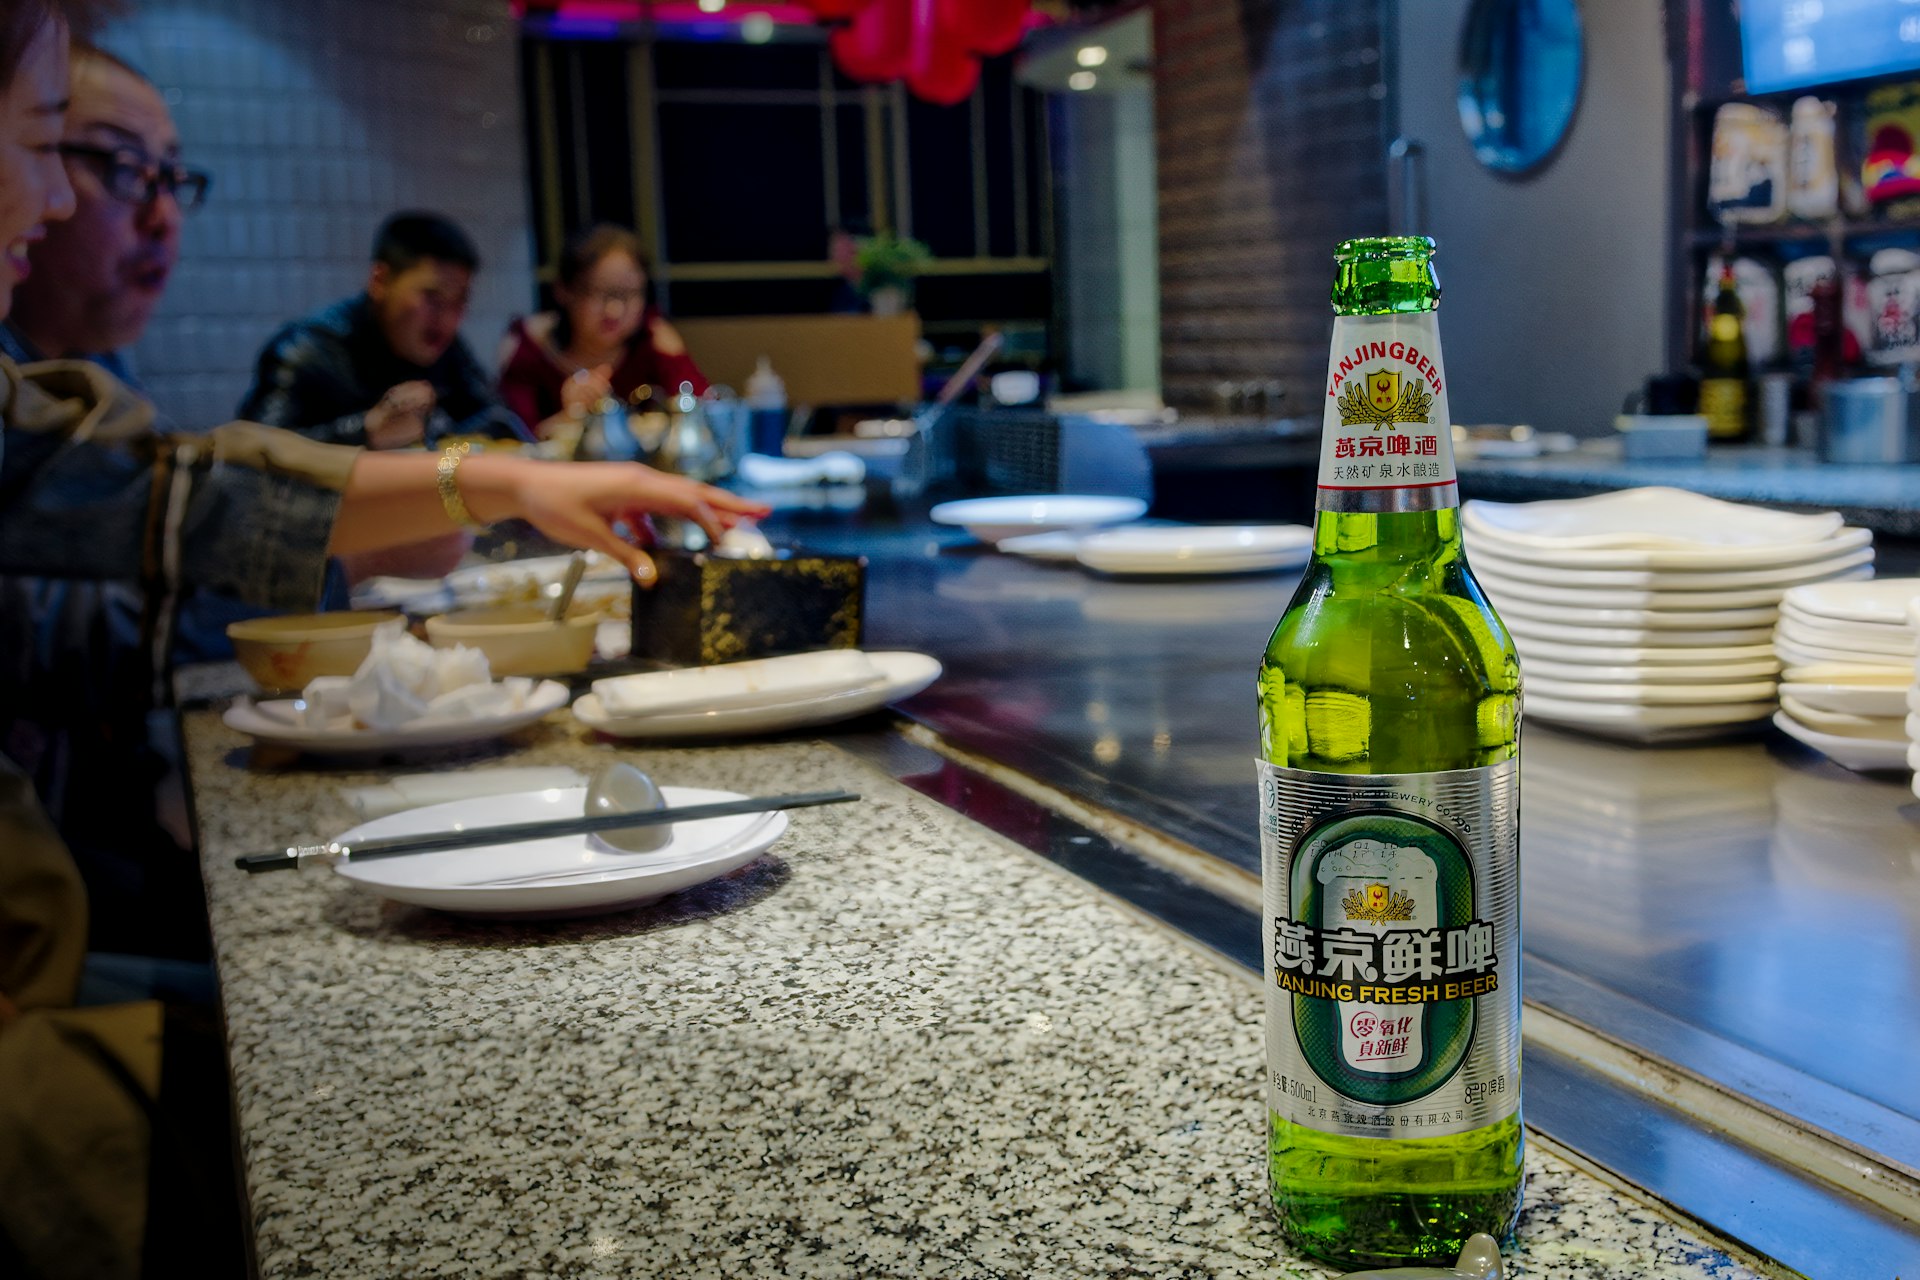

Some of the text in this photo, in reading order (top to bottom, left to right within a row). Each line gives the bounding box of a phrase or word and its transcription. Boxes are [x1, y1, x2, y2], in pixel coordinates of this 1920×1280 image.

[1328, 341, 1442, 397] YANJINGBEER
[1335, 435, 1437, 458] 燕京啤酒
[1333, 462, 1440, 480] 天然矿泉水酿造
[1275, 919, 1498, 983] 燕京鲜啤
[1275, 970, 1497, 1003] YANJING FRESH BEER
